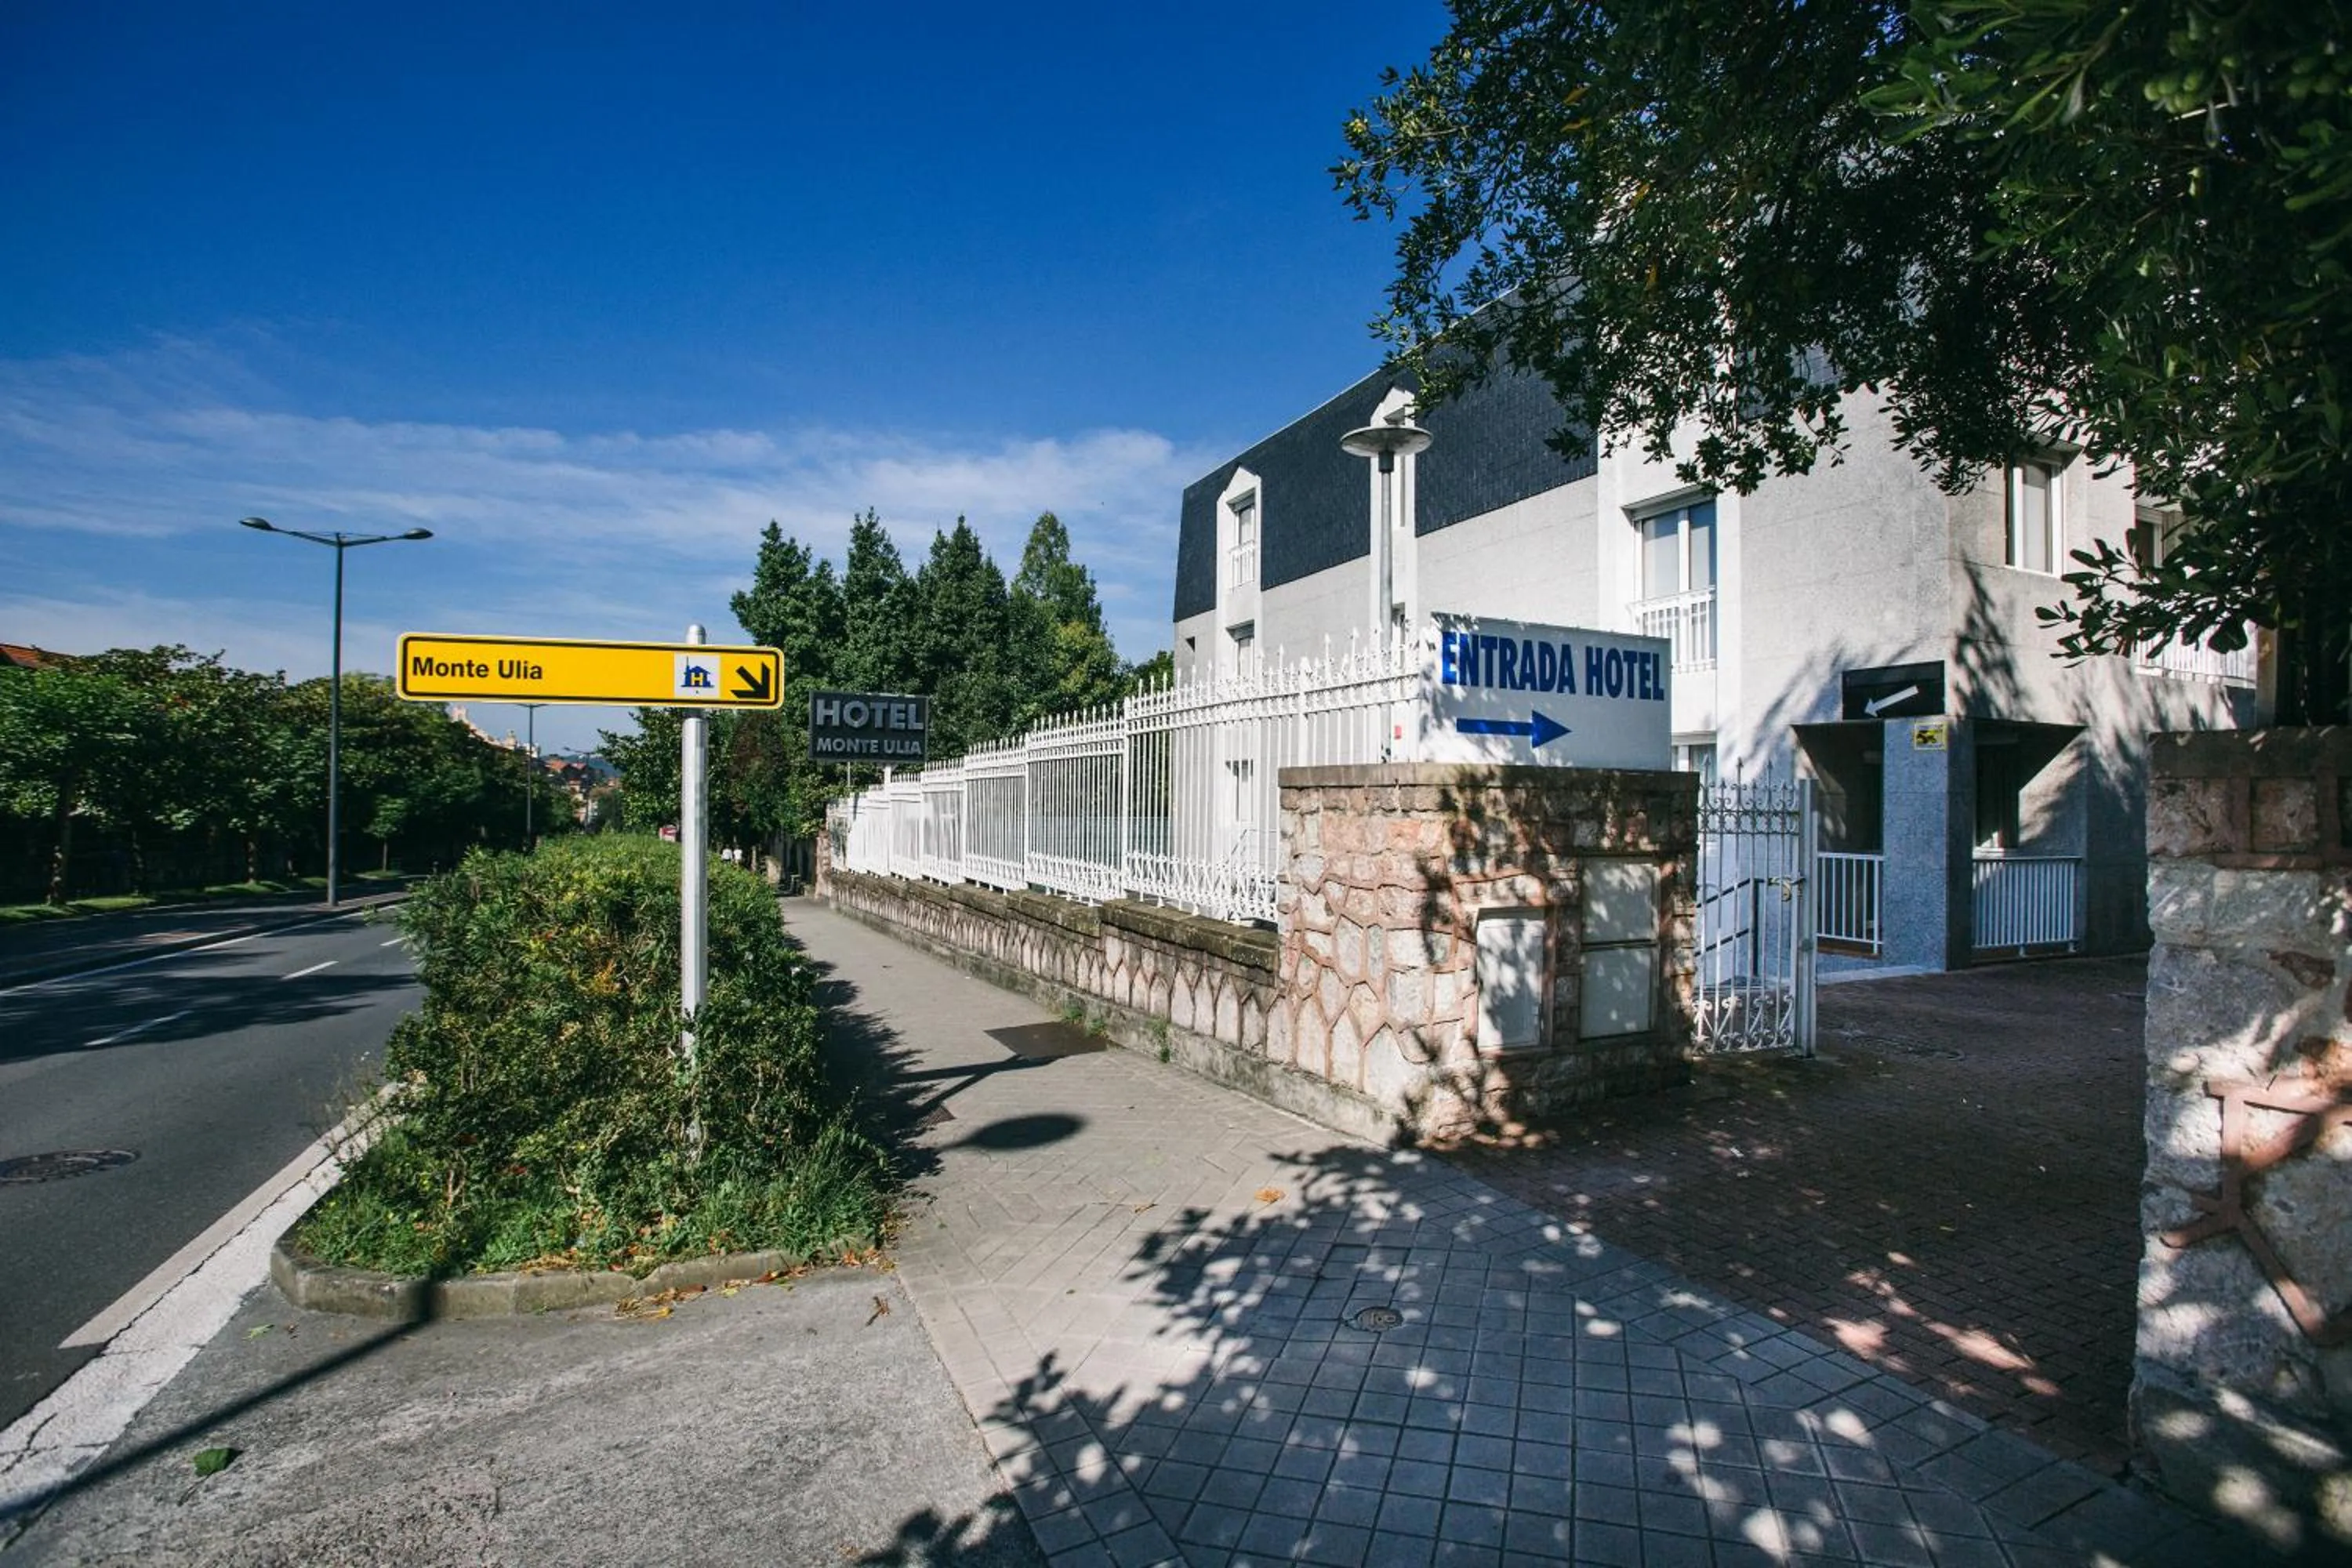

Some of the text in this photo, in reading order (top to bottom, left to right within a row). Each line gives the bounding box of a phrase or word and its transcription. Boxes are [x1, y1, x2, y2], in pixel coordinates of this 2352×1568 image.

[412, 656, 543, 680] Monte Ulia
[1441, 631, 1664, 701] ENTRADA HOTEL
[815, 699, 924, 730] HOTEL
[816, 738, 921, 754] MONTE ULIA
